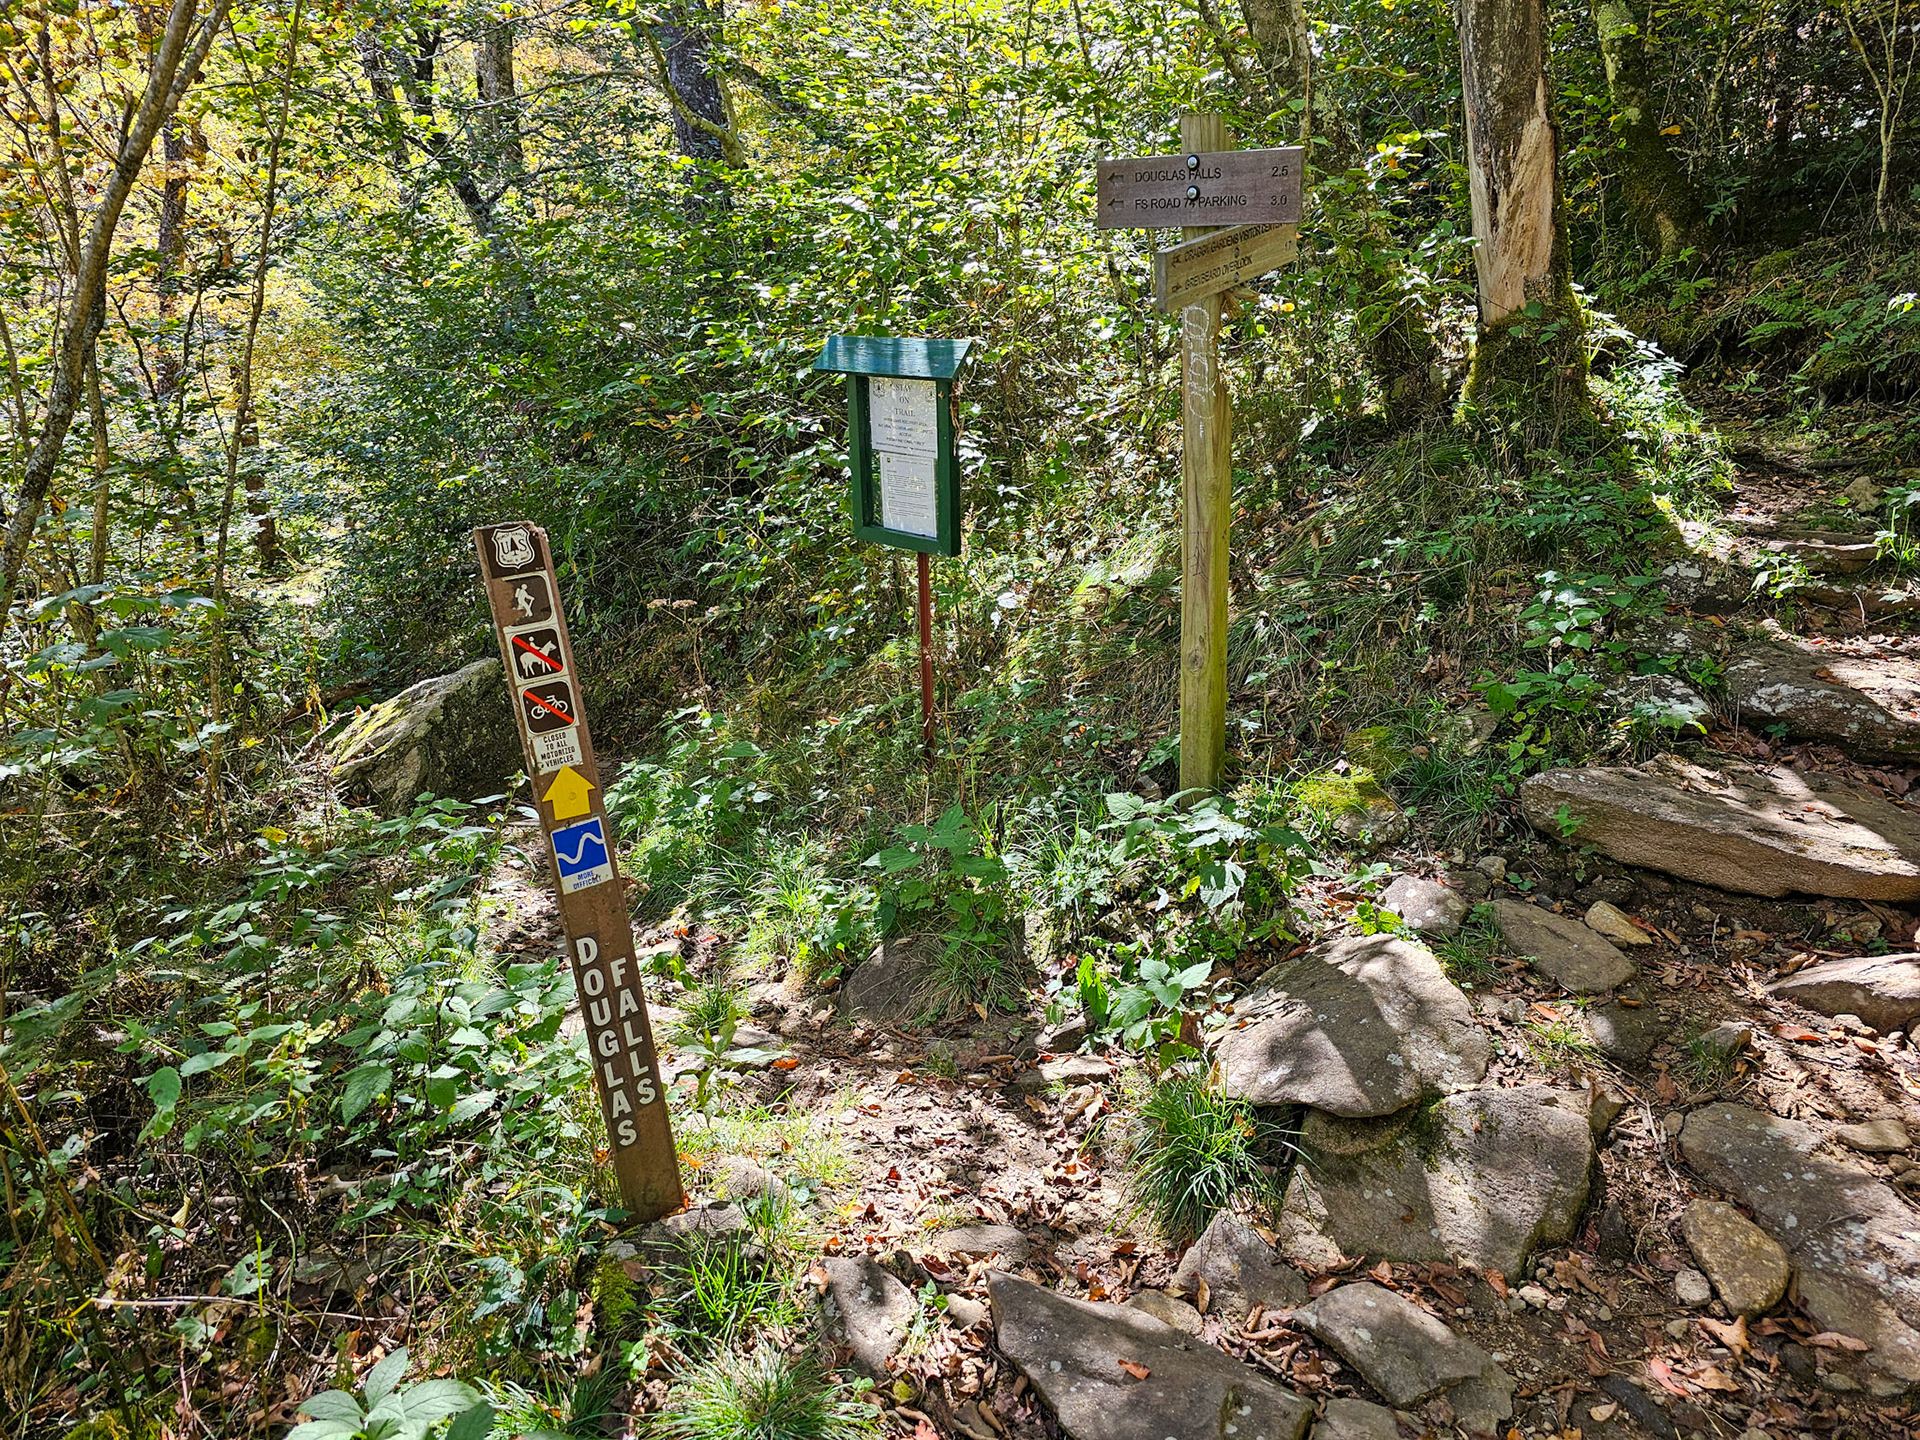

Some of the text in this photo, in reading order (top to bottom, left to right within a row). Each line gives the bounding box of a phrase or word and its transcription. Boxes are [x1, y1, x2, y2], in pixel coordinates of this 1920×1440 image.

[1135, 165, 1289, 183] DOUGLAS FALLS 2.5
[1135, 198, 1149, 210] FS
[1150, 197, 1181, 210] ROAD
[1198, 194, 1248, 208] PARKING
[1270, 194, 1288, 206] 3.0
[1210, 232, 1239, 253] GARDENS
[1239, 224, 1261, 243] VISITOR
[1222, 254, 1253, 276] OVERLOOK
[895, 383, 913, 392] STAY
[899, 396, 910, 404] ON
[894, 408, 916, 417] TRAIL
[543, 731, 567, 744] CLOSED
[540, 745, 576, 760] MOTORIZED
[546, 740, 568, 751] TO ALL
[545, 754, 574, 767] VEHICLES
[577, 870, 594, 880] MORE
[610, 957, 656, 1105] FALLS
[576, 937, 637, 1146] DOUGLAS
